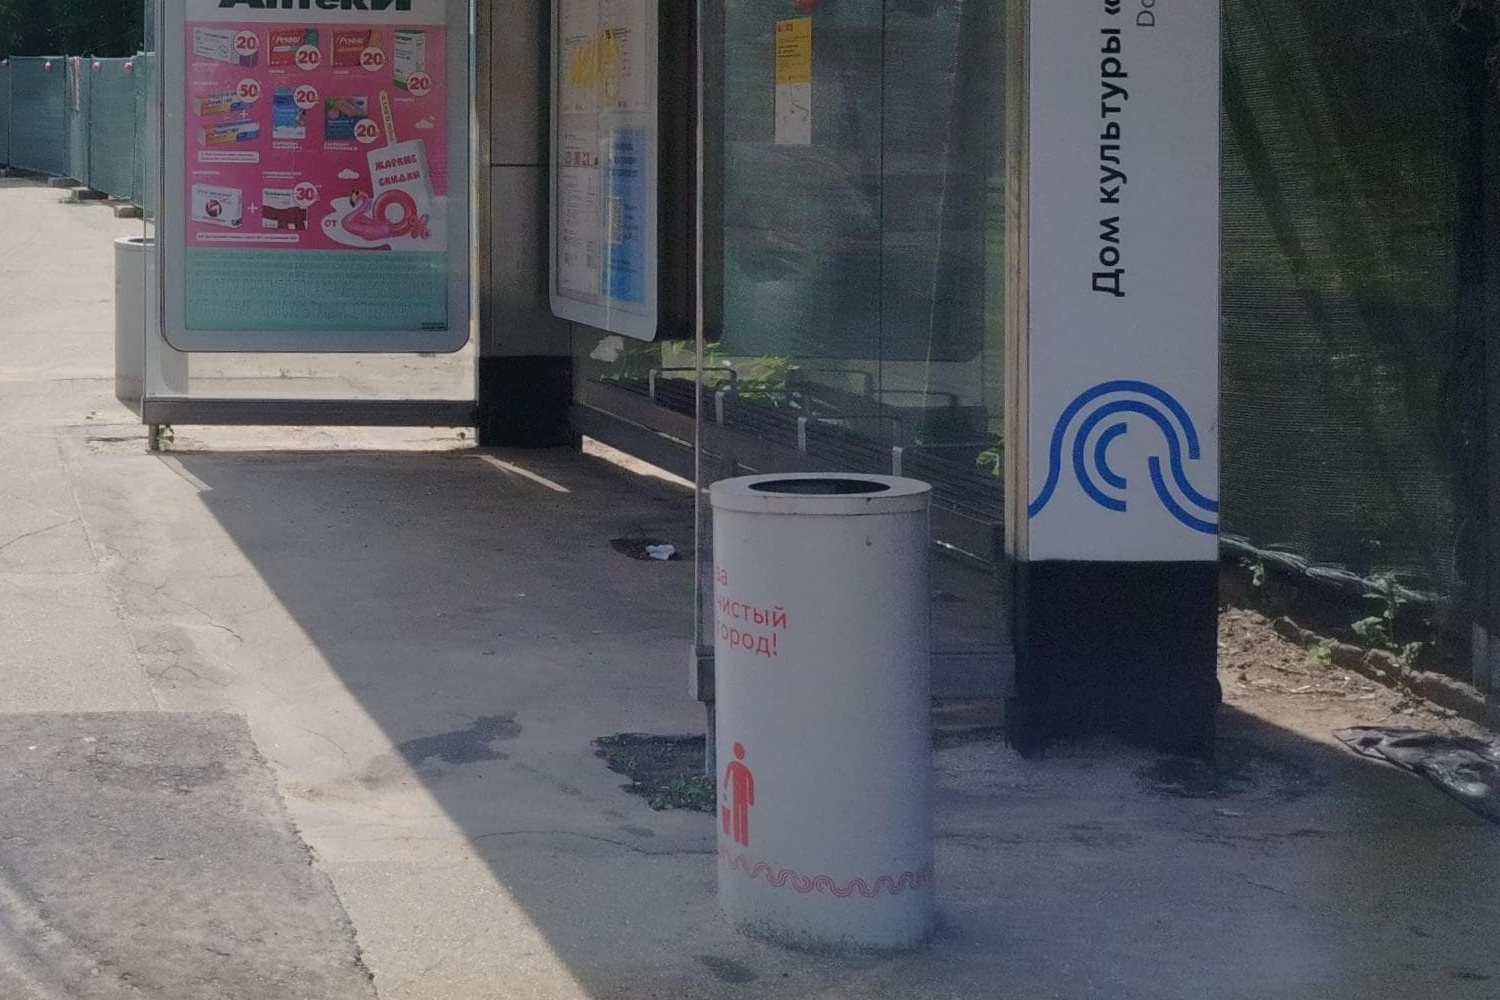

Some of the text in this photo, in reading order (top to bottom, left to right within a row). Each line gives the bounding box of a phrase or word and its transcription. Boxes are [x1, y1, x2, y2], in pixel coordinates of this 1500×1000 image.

[1100, 29, 1128, 203] культуры
[375, 154, 418, 171] ЖАРКИЕ
[378, 170, 421, 187] СКИДКИ
[1092, 216, 1126, 297] Дом
